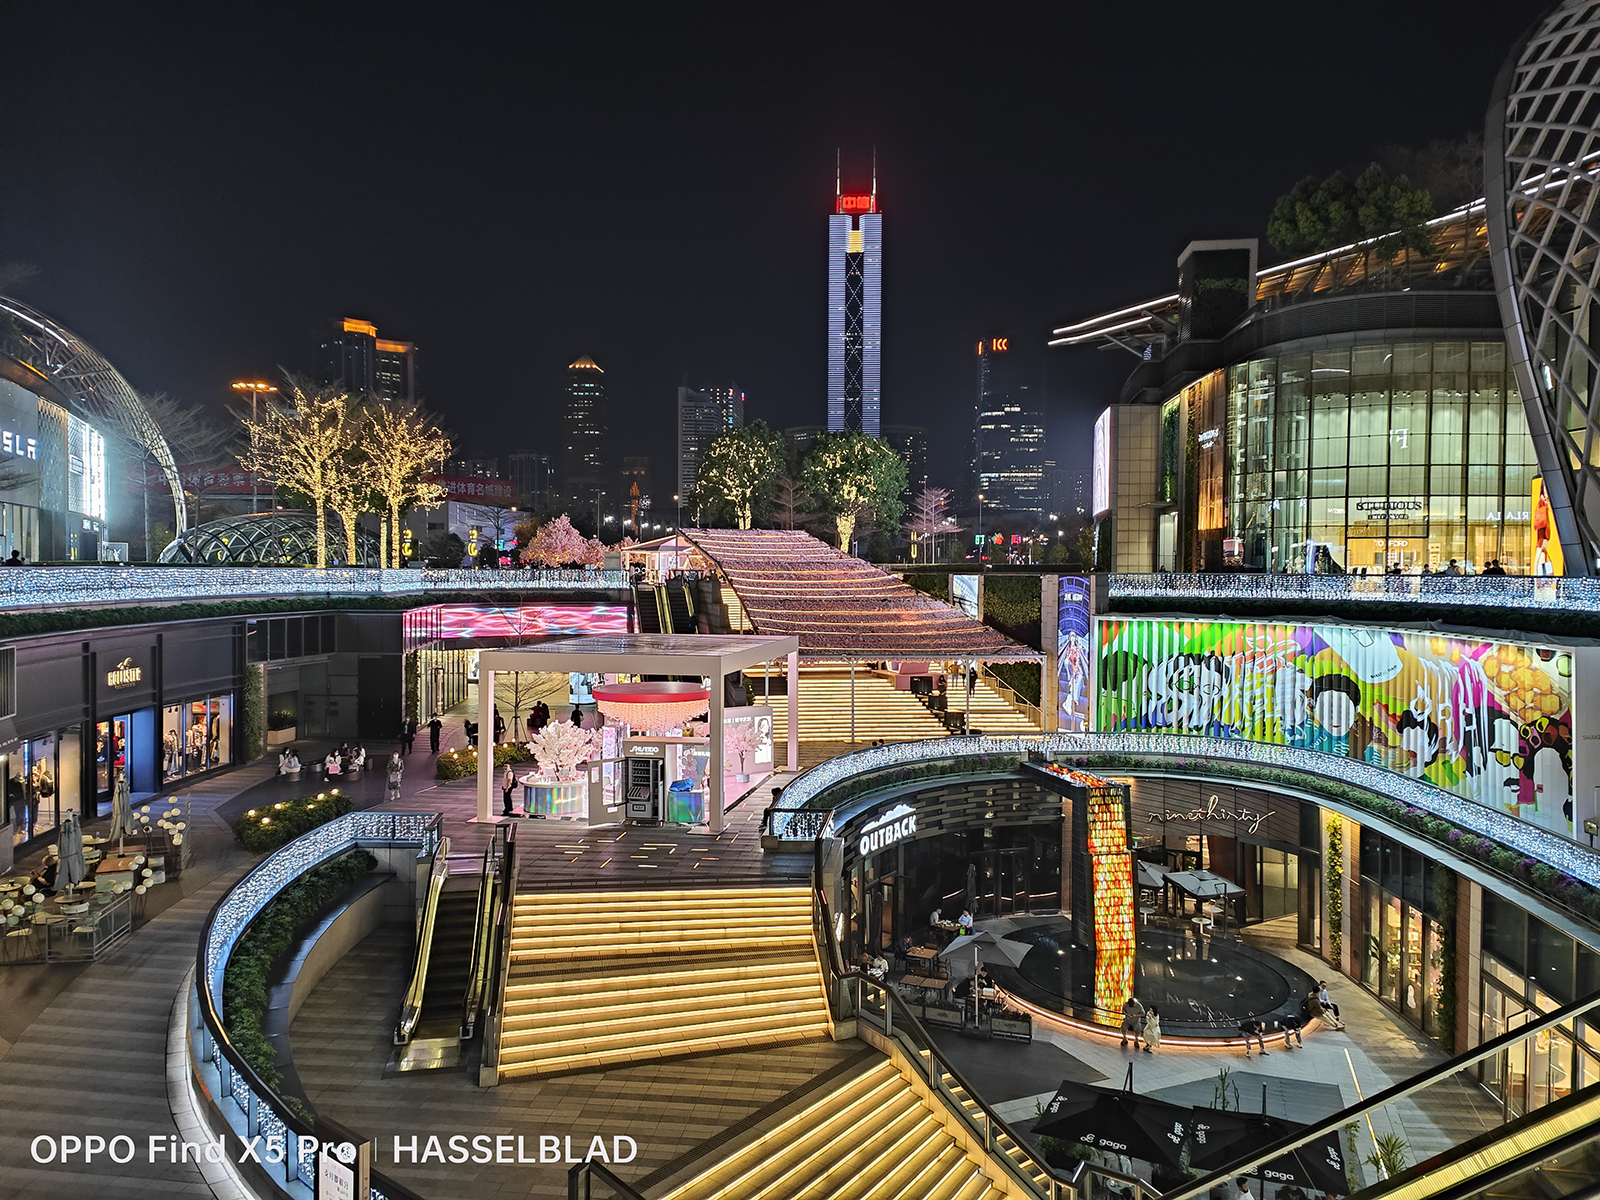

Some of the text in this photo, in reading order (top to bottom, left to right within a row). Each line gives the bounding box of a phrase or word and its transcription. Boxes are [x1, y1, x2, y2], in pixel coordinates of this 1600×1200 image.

[842, 196, 870, 209] 中信
[992, 338, 1008, 351] ICC
[1148, 795, 1276, 835] ninethirty
[860, 815, 916, 855] OUTBACK
[1099, 1138, 1127, 1151] gaga
[1264, 1169, 1295, 1181] gaga
